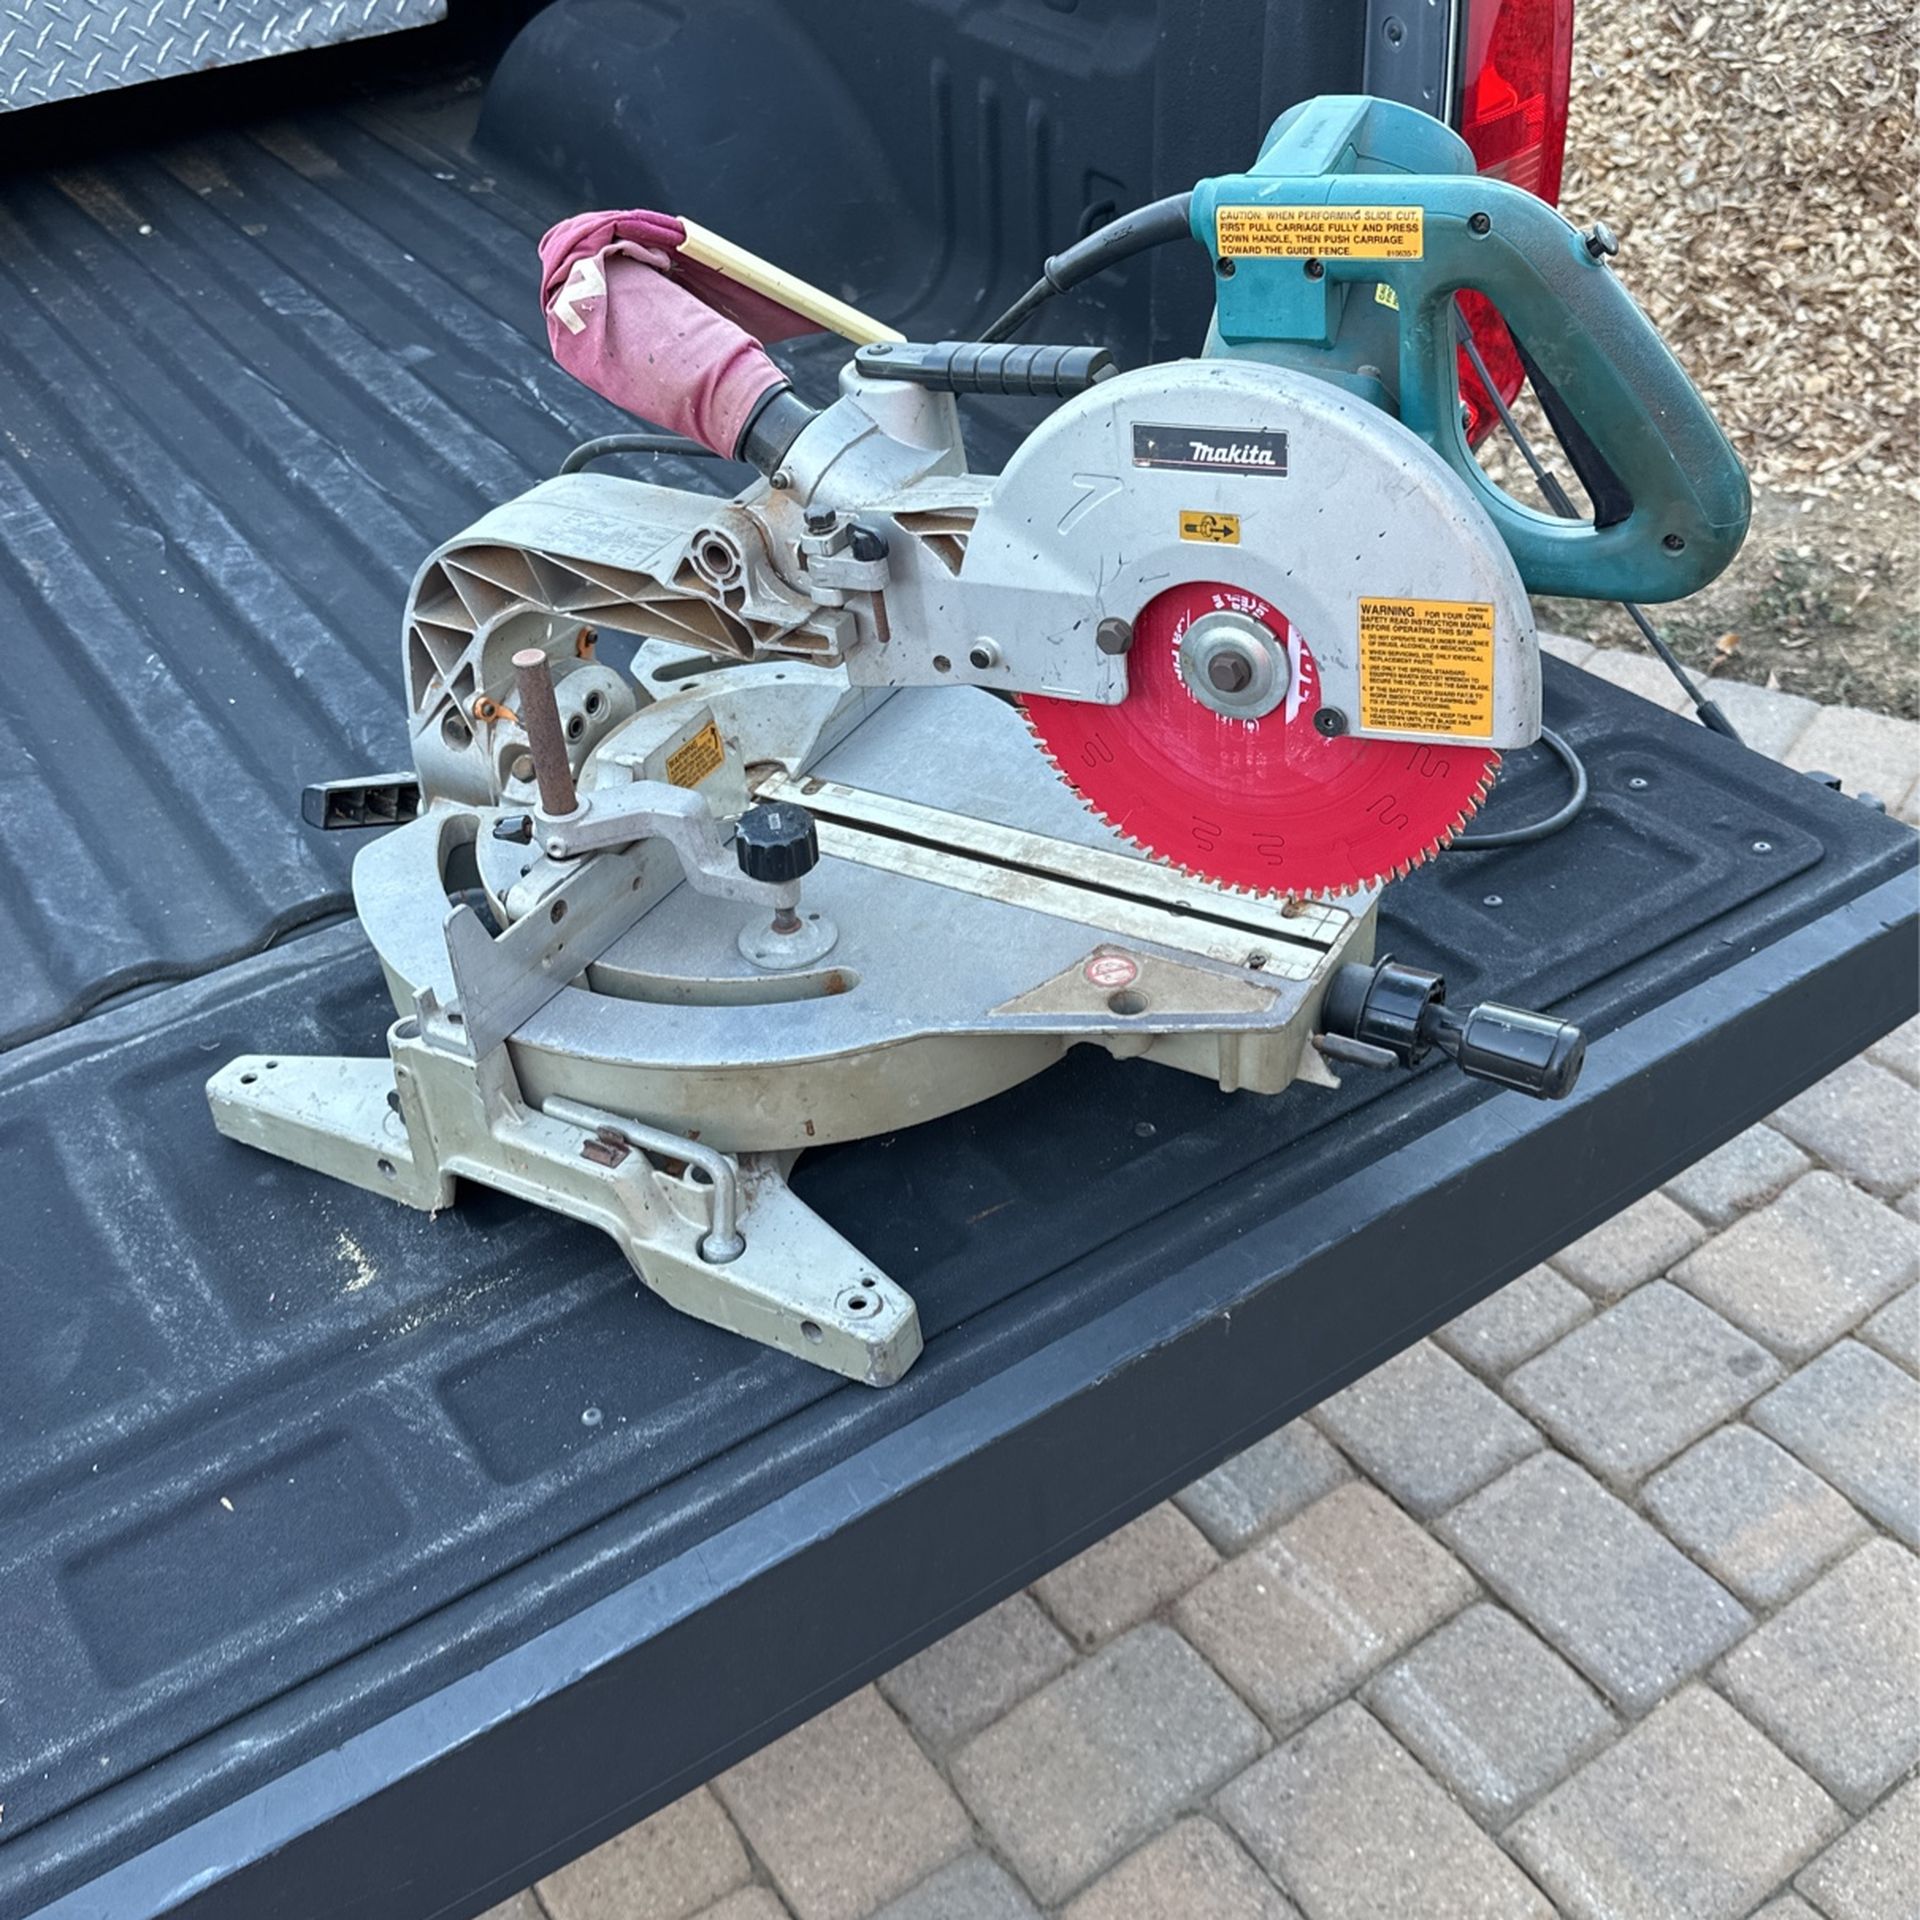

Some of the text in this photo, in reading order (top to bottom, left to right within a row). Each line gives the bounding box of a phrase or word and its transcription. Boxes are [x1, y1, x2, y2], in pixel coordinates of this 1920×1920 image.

[1267, 211, 1294, 220] WHEN
[1298, 210, 1361, 221] PERFORMING
[1364, 211, 1392, 221] SLIDE
[1220, 223, 1419, 233] FIRST PULL CARRIAGE FULLY AND PRESS
[1221, 234, 1404, 244] DOWN HANDLE, THEN PUSH CARRIAGE
[1222, 246, 1352, 256] TOWARD THE GUIDE FENCE.
[1189, 441, 1276, 466] Makita
[1360, 604, 1414, 616] WARNING
[1411, 619, 1458, 627] INSTRUCTION
[1460, 621, 1490, 629] MANUAL
[1392, 625, 1435, 634] OPERATING
